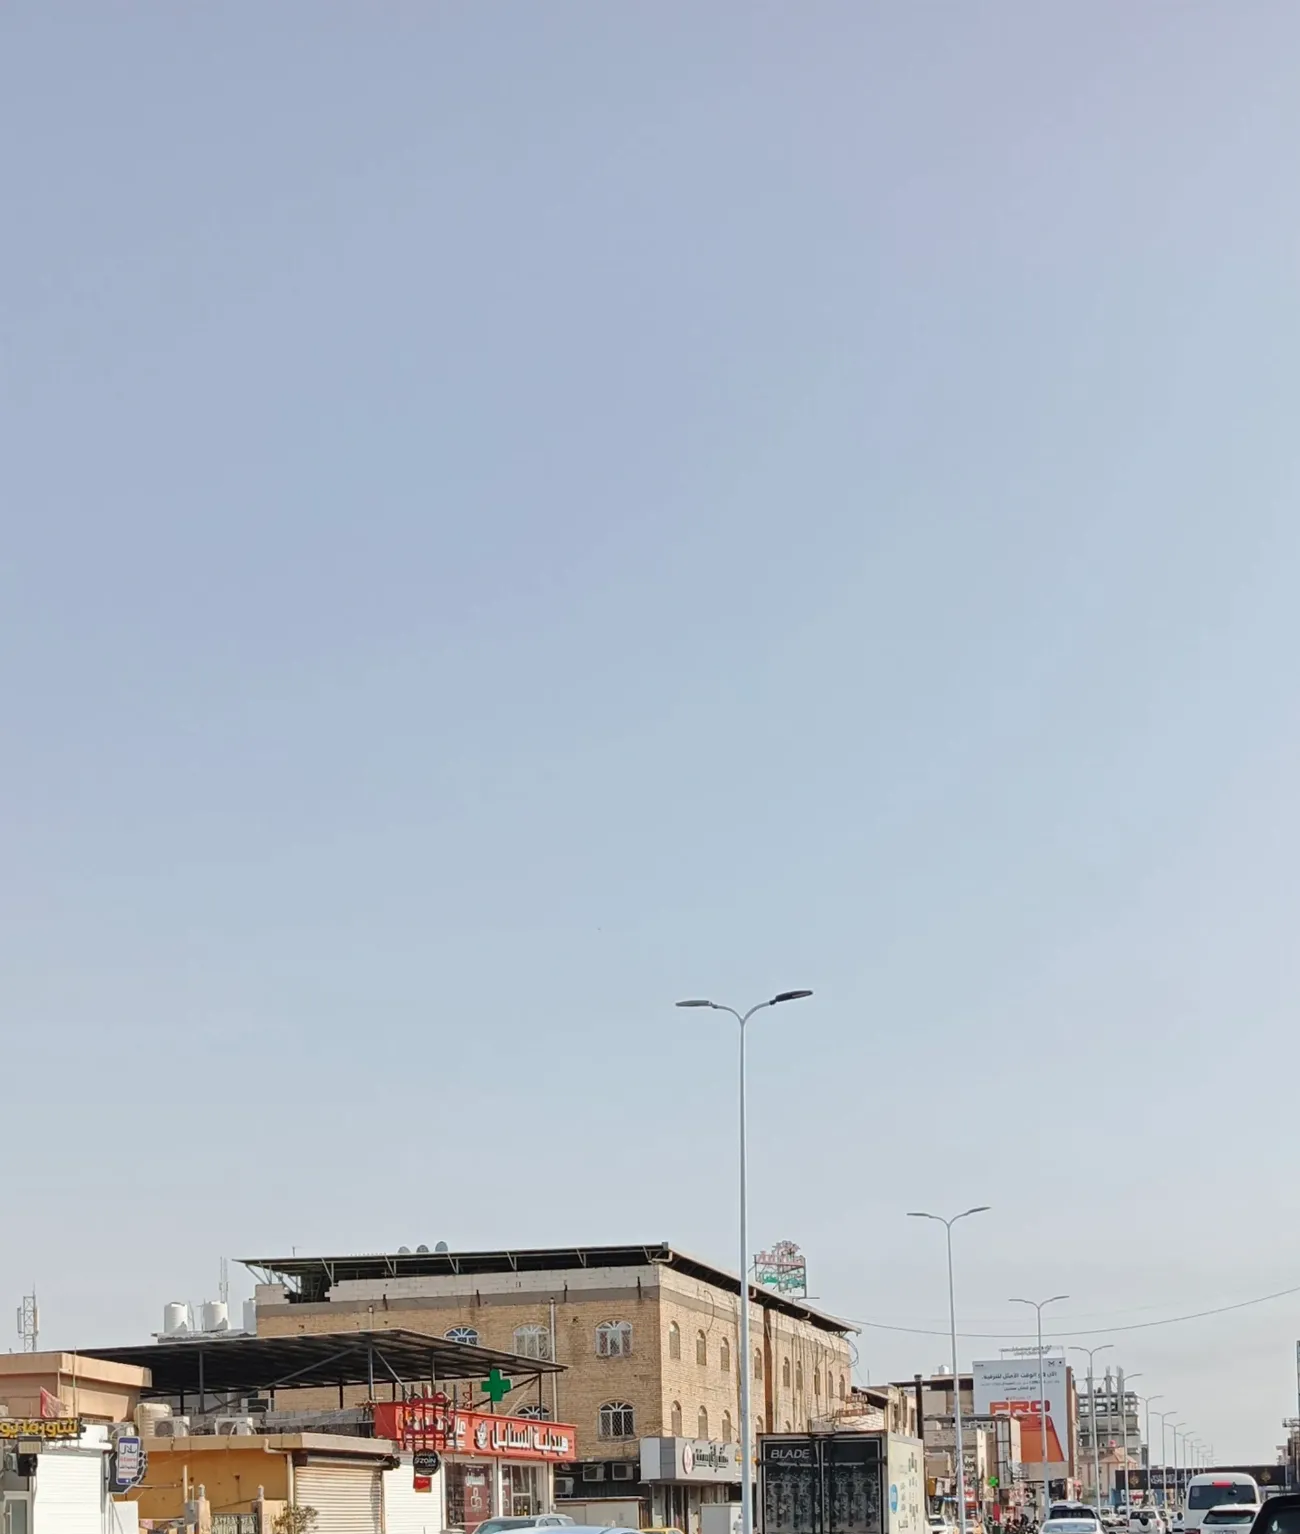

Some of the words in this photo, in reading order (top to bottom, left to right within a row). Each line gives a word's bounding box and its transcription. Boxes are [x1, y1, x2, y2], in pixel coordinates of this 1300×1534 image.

[989, 1400, 1050, 1416] PRO
[490, 1421, 533, 1452] السنابل
[533, 1426, 569, 1456] صيدلية
[770, 1449, 810, 1459] BLADE
